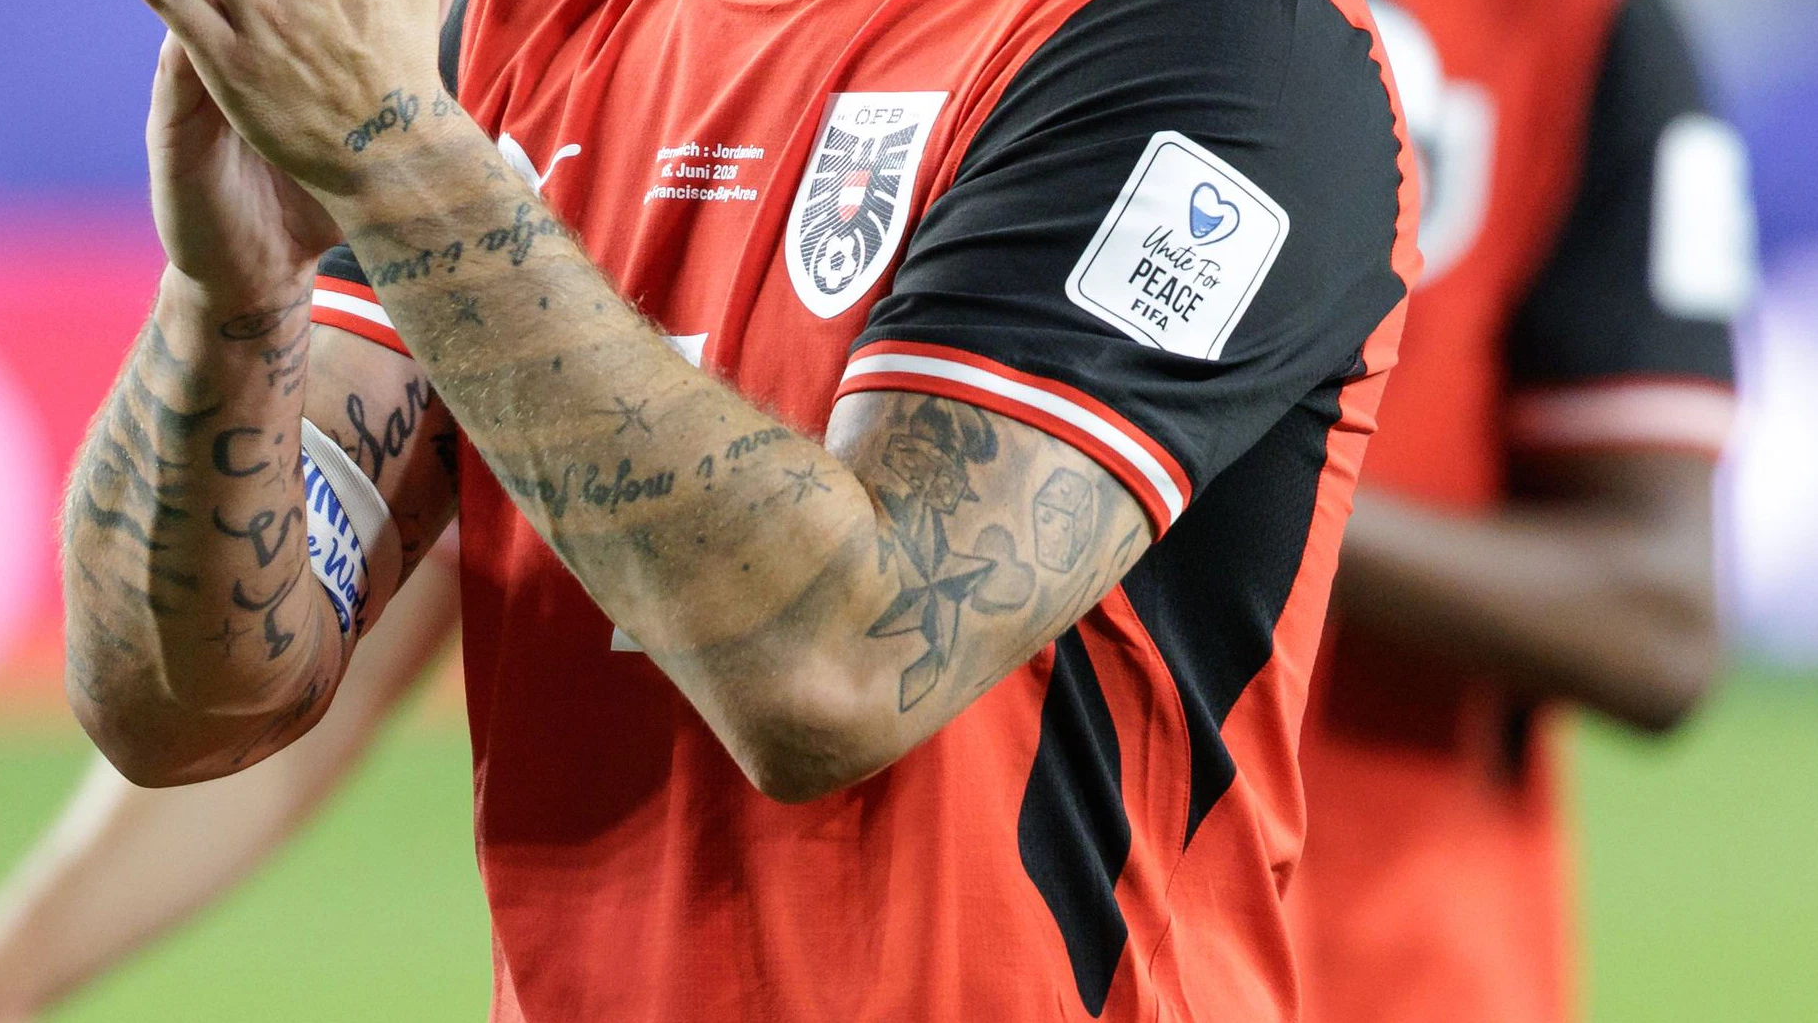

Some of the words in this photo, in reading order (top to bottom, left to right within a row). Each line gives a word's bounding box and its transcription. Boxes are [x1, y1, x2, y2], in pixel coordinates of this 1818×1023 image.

[676, 162, 710, 180] Juni
[1142, 224, 1197, 271] Unite
[1193, 259, 1221, 290] For
[1128, 257, 1204, 323] PEACE
[1131, 298, 1169, 331] FIFA
